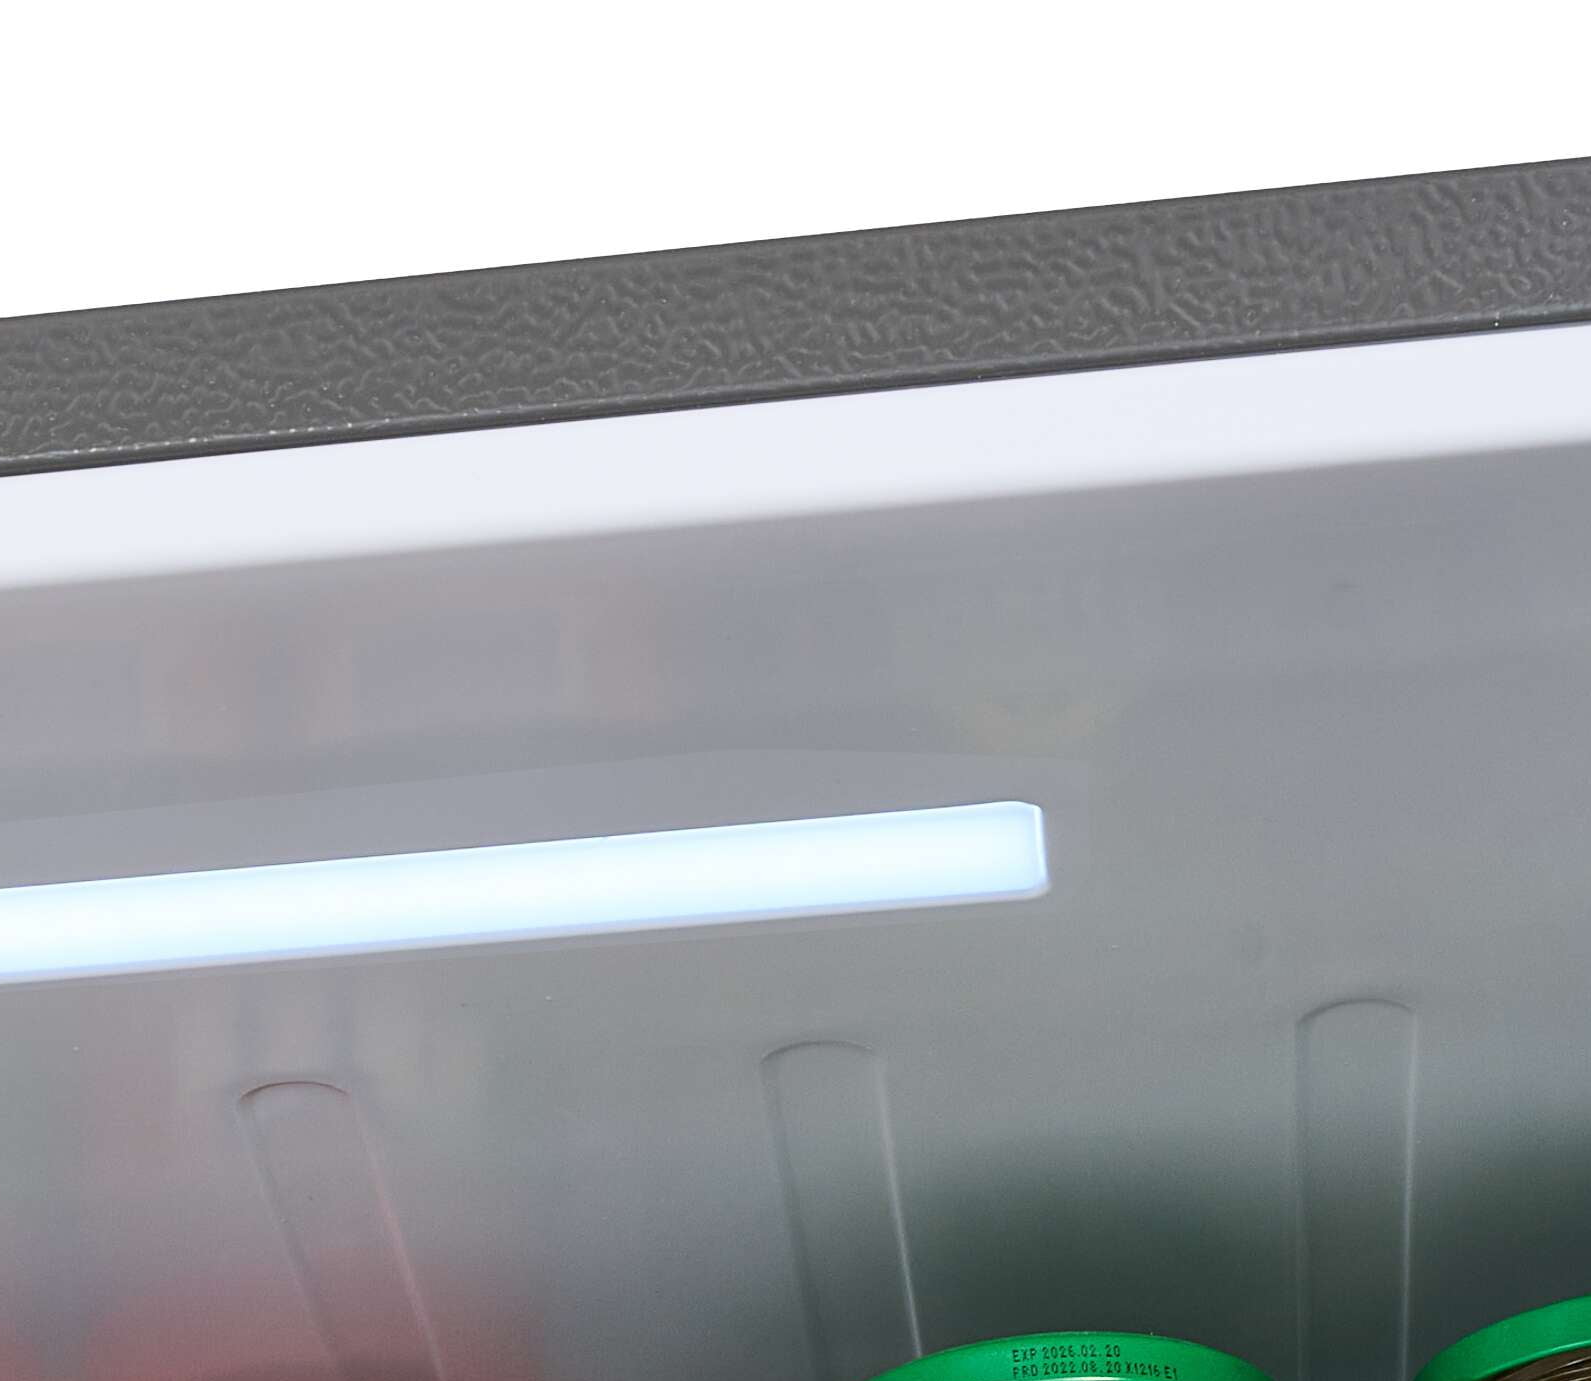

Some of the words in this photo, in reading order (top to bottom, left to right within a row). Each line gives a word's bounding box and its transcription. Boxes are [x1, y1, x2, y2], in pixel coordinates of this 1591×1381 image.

[1012, 1348, 1037, 1363] EXP
[1042, 1344, 1121, 1360] 2026.02.20
[1012, 1364, 1038, 1378] PRD
[1042, 1360, 1122, 1376] 2022.08.20
